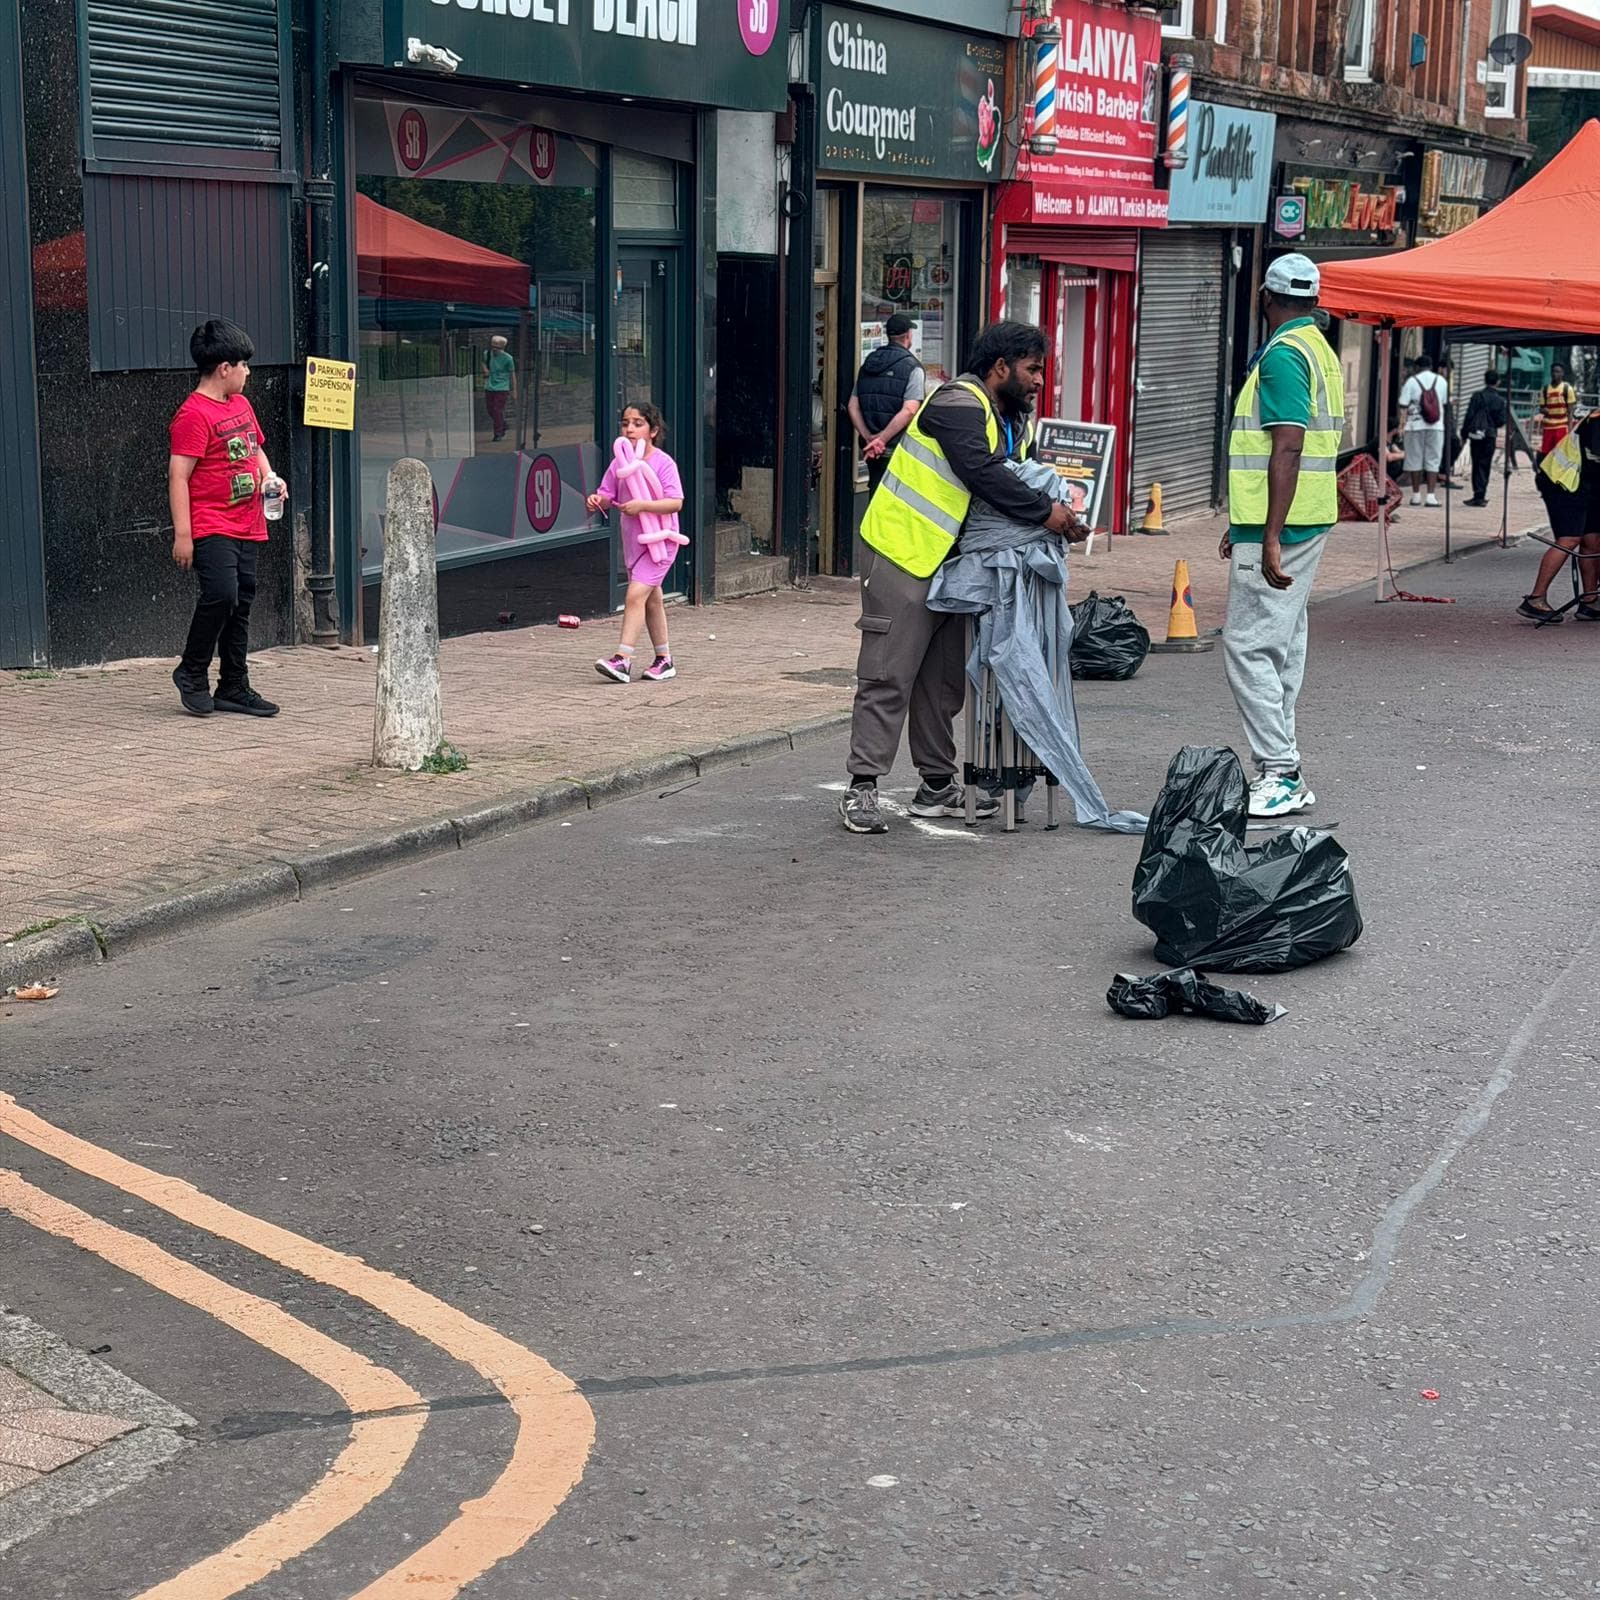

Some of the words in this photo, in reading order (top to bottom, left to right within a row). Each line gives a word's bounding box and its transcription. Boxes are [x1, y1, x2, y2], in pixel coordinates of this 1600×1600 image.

[827, 21, 887, 75] China
[1096, 87, 1140, 120] Barber
[826, 87, 916, 160] Gourmet
[1080, 127, 1105, 143] Efficient
[1105, 130, 1126, 146] Service
[406, 120, 420, 159] SB
[536, 132, 549, 168] SB
[825, 145, 871, 161] ORIENTAL
[1035, 192, 1072, 214] Welcome
[1076, 195, 1085, 215] to
[1088, 195, 1119, 216] ALANYA
[1120, 197, 1146, 217] Turkish
[1146, 199, 1169, 218] Barber
[309, 378, 352, 391] SUSPENSION
[317, 365, 346, 377] PARKING
[1051, 429, 1098, 442] ALANYA
[535, 469, 551, 518] SB
